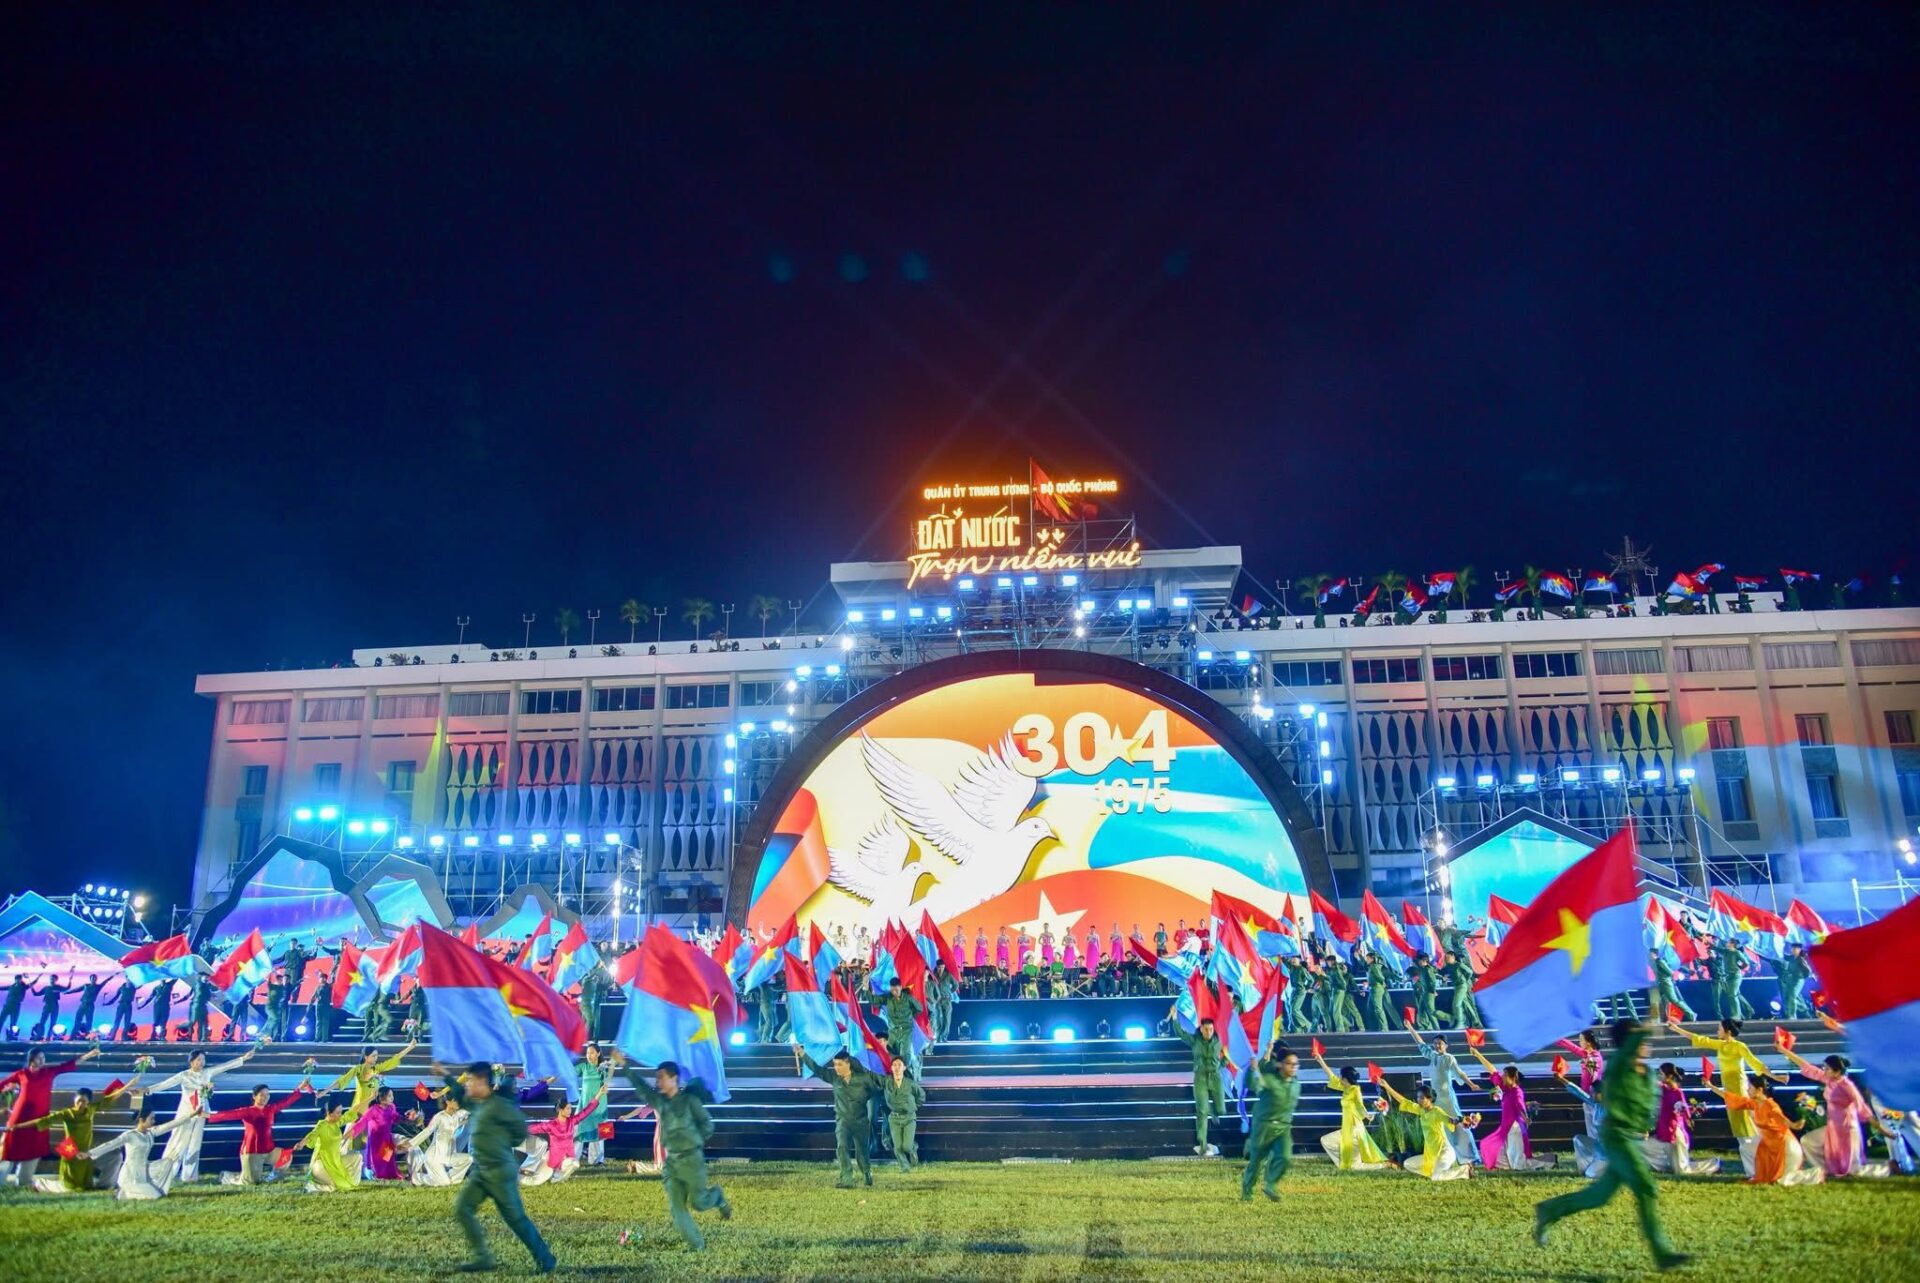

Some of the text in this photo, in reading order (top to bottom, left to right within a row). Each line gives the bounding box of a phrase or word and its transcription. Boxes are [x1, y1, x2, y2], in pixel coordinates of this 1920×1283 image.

[924, 485, 951, 500] QUÂN
[953, 483, 966, 498] ỦY
[968, 485, 1000, 497] TRUNG
[1002, 484, 1030, 496] ƯƠNG
[1040, 481, 1054, 496] BỘ
[1056, 479, 1082, 493] QUỐC
[1083, 479, 1118, 493] PHÒNG
[918, 503, 1021, 550] ĐẤT NƯỚC
[907, 542, 1142, 590] Trọn niềm vui
[1094, 776, 1173, 816] 1975
